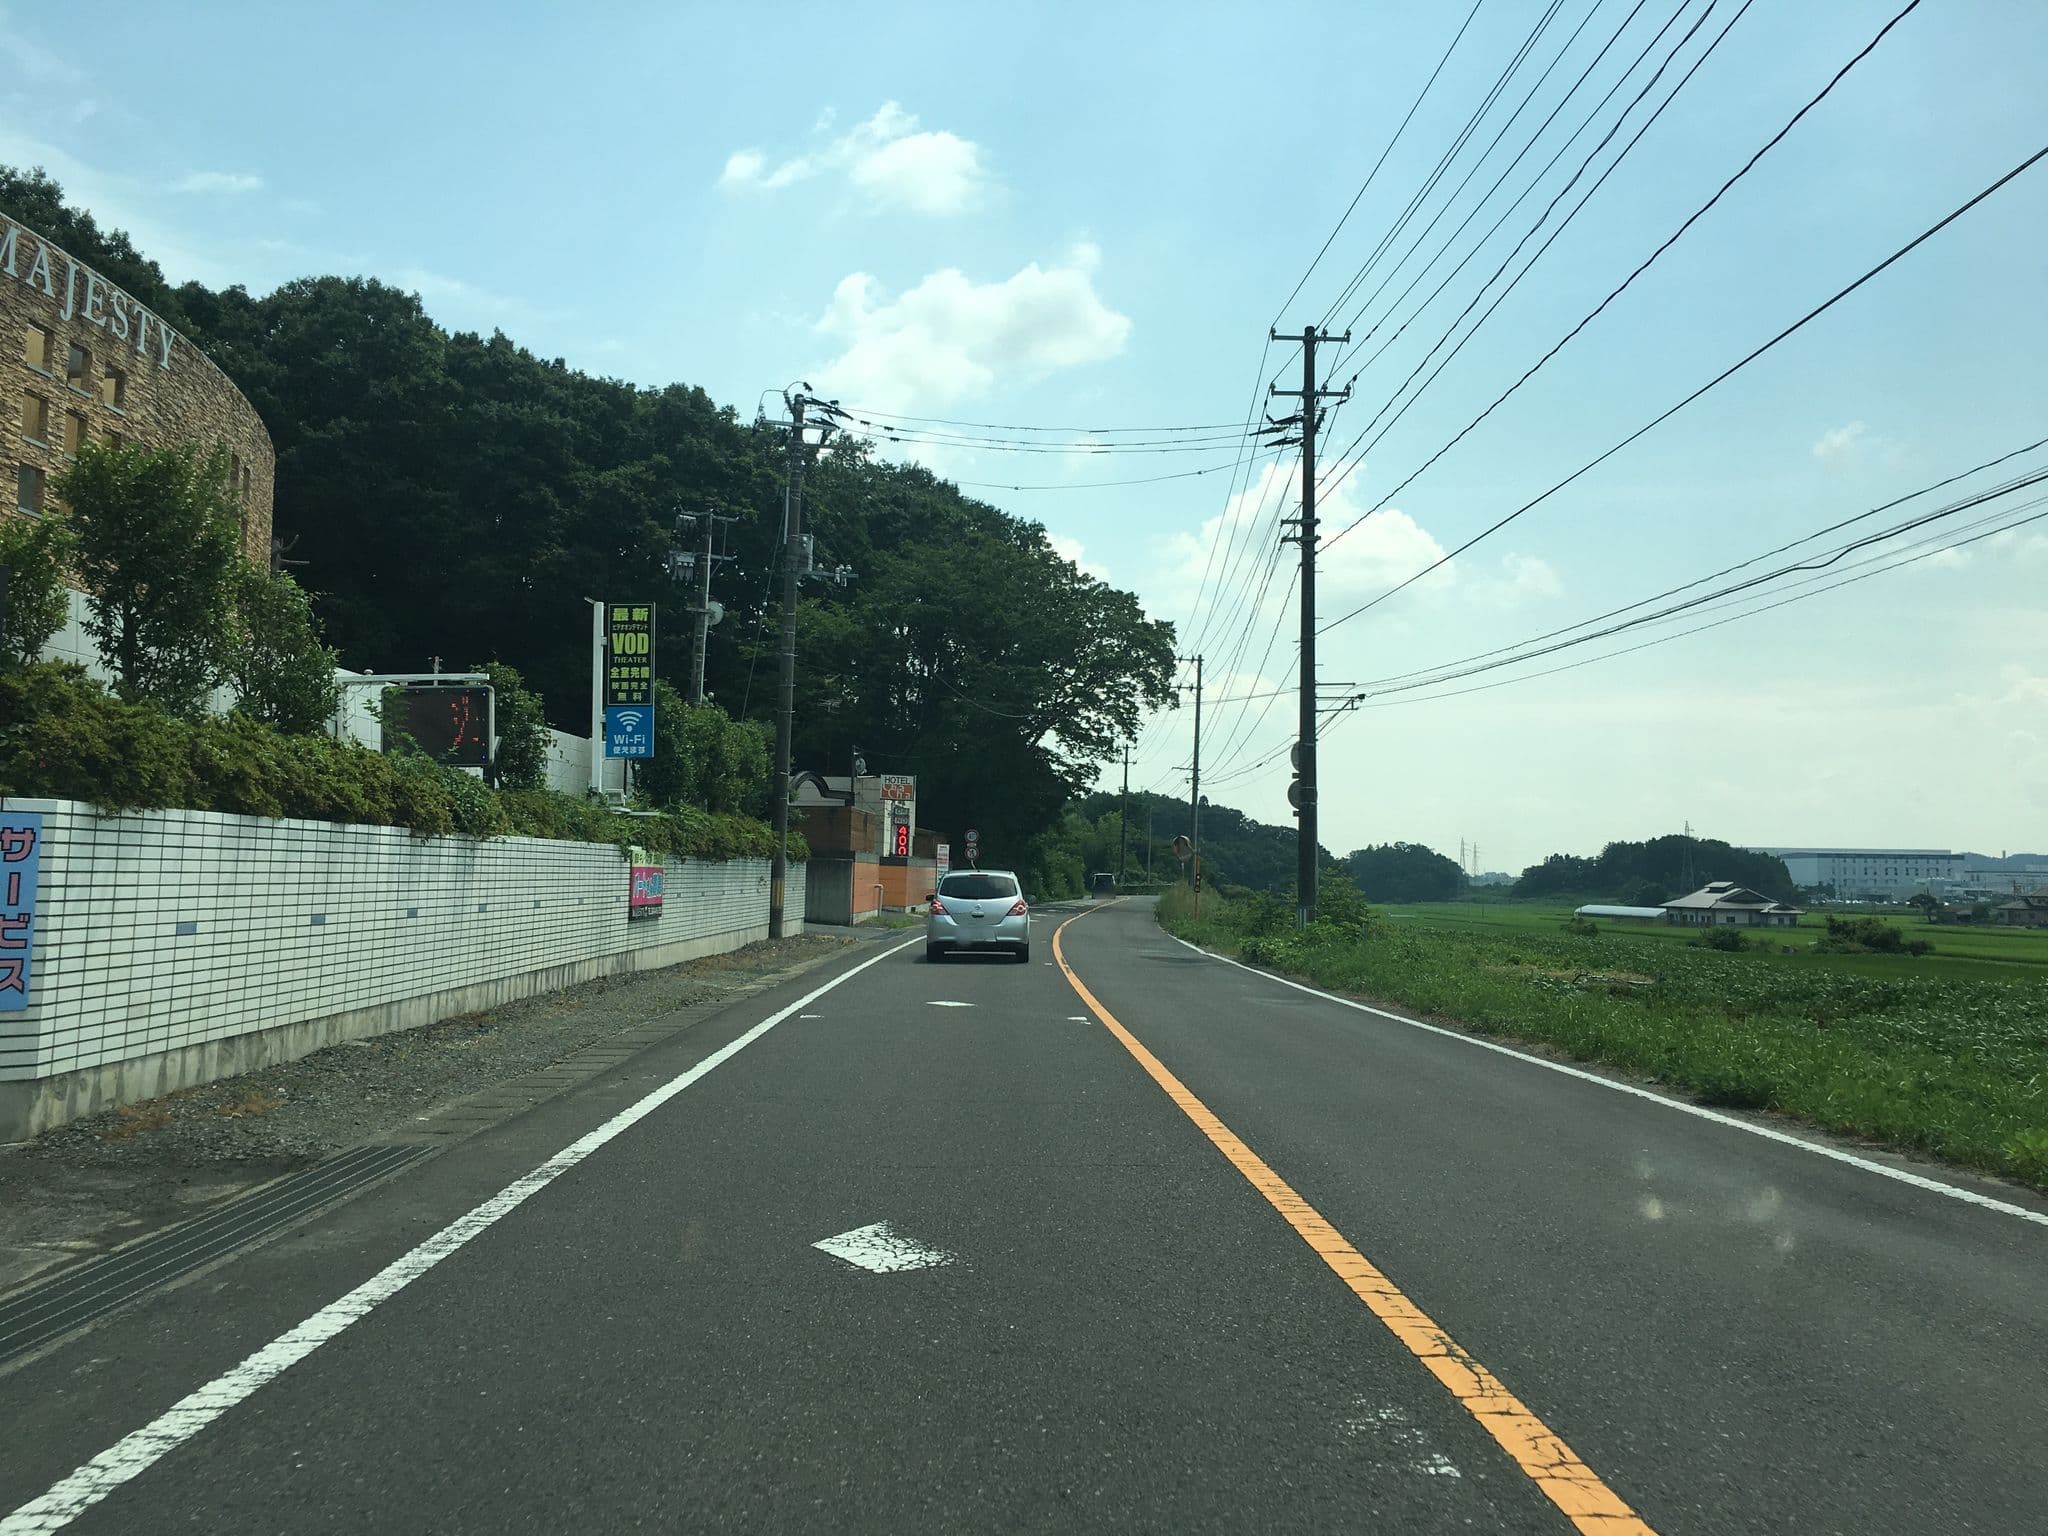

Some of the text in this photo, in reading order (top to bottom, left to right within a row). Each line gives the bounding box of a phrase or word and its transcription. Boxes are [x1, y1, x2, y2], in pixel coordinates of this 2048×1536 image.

[612, 607, 649, 622] 最新
[612, 633, 649, 655] VOD
[613, 656, 648, 664] THEATER
[610, 666, 650, 679] 全室完備
[613, 734, 646, 745] Wi-Fi
[884, 776, 910, 785] HOTEL
[0, 826, 36, 995] サービス
